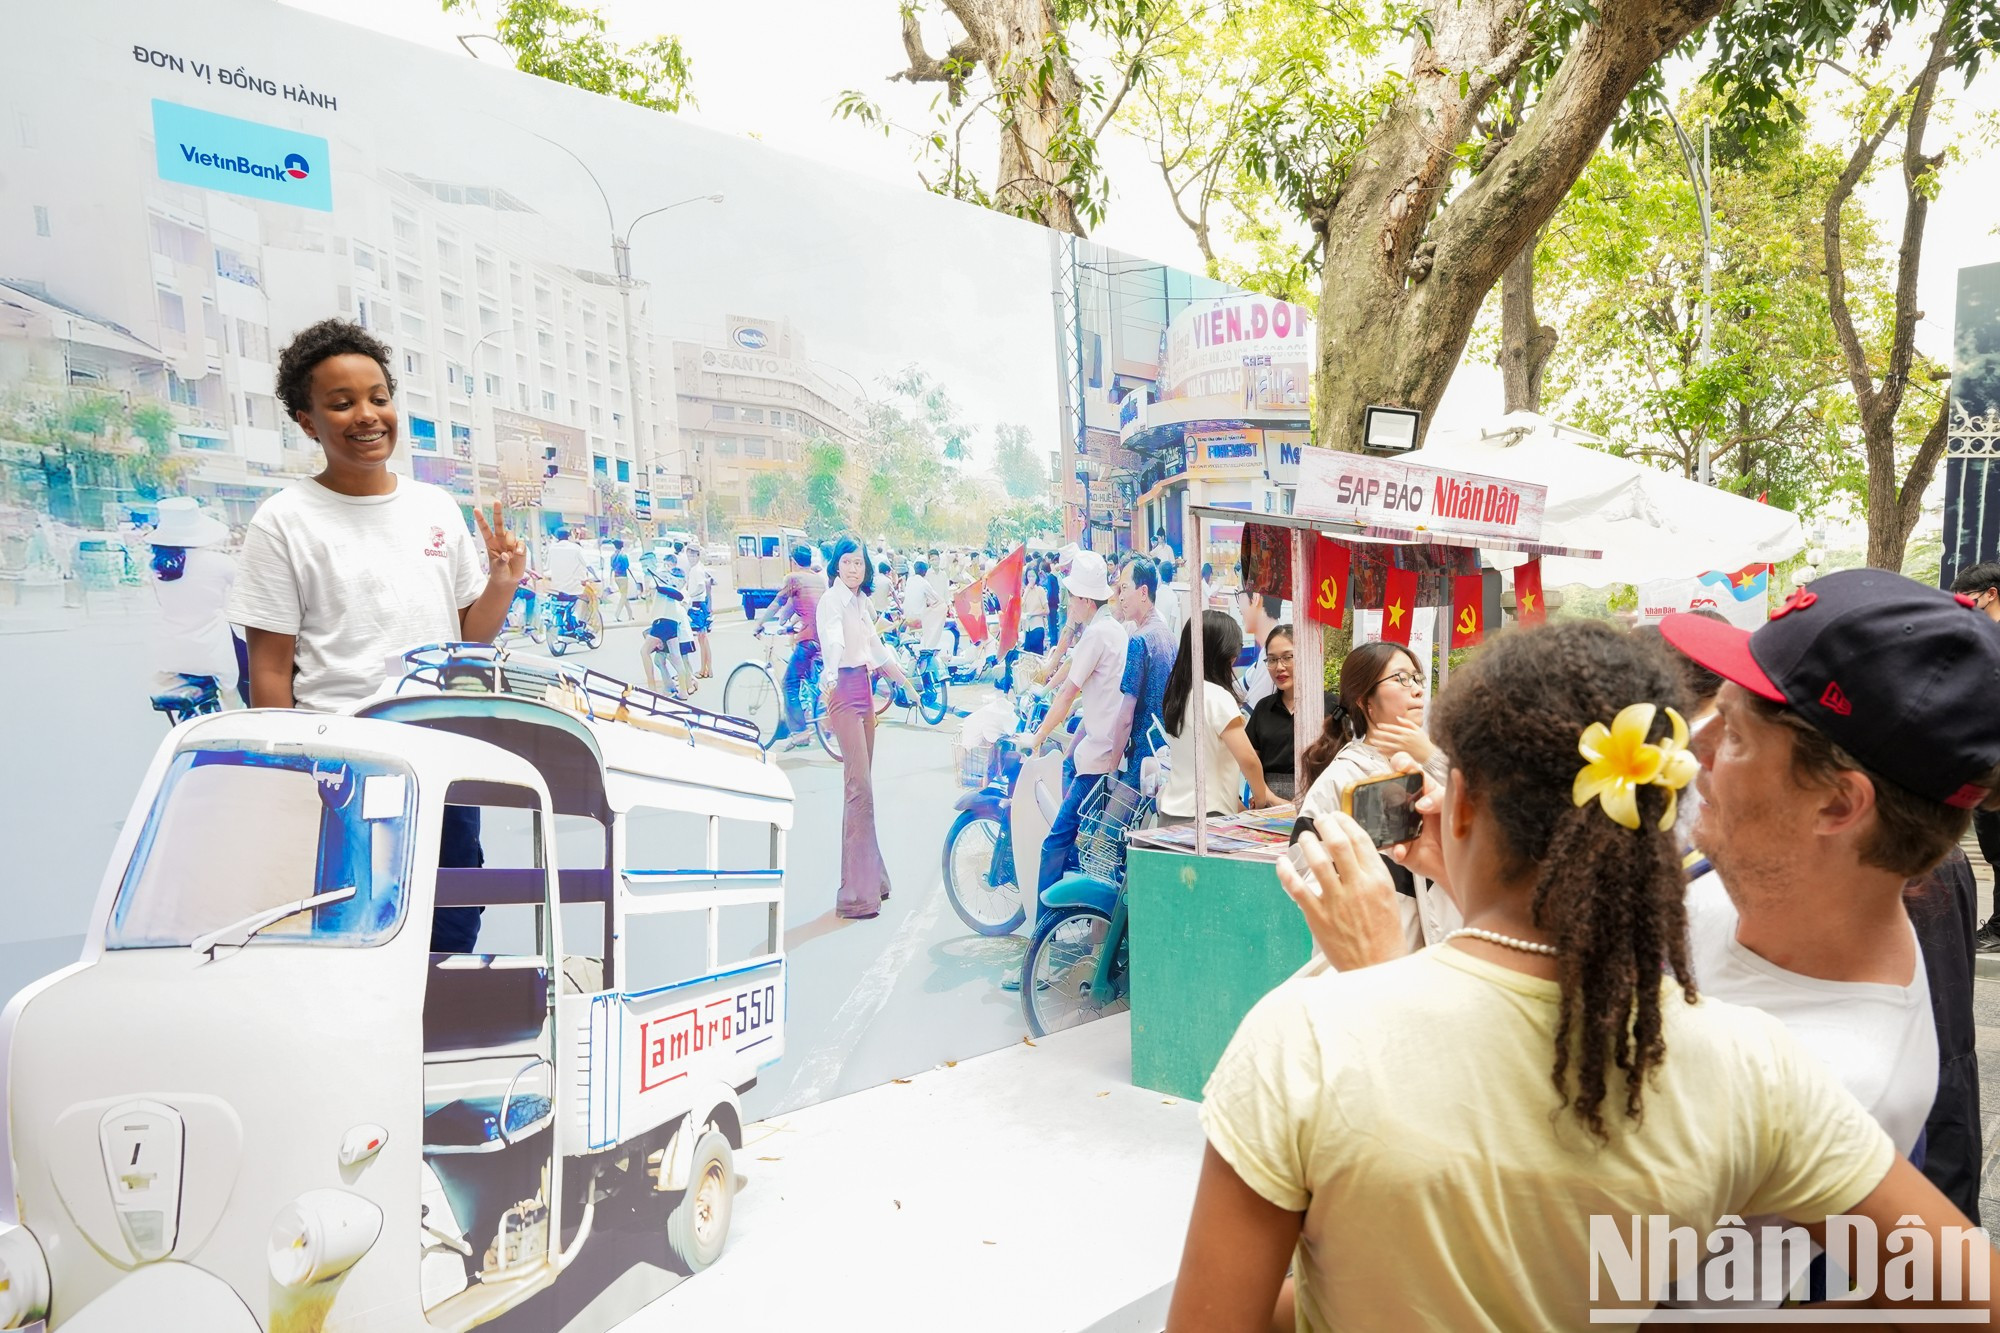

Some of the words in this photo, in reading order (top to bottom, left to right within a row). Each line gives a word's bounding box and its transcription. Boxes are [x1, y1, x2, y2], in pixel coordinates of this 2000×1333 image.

[132, 45, 184, 73] ĐƠN
[191, 60, 211, 84] VỊ
[218, 66, 277, 96] ĐỒNG
[283, 84, 337, 111] HÀNH
[179, 143, 287, 182] VietinBank
[718, 352, 779, 374] SANYO
[1383, 467, 1423, 512] BÁO
[736, 985, 774, 1035] 550
